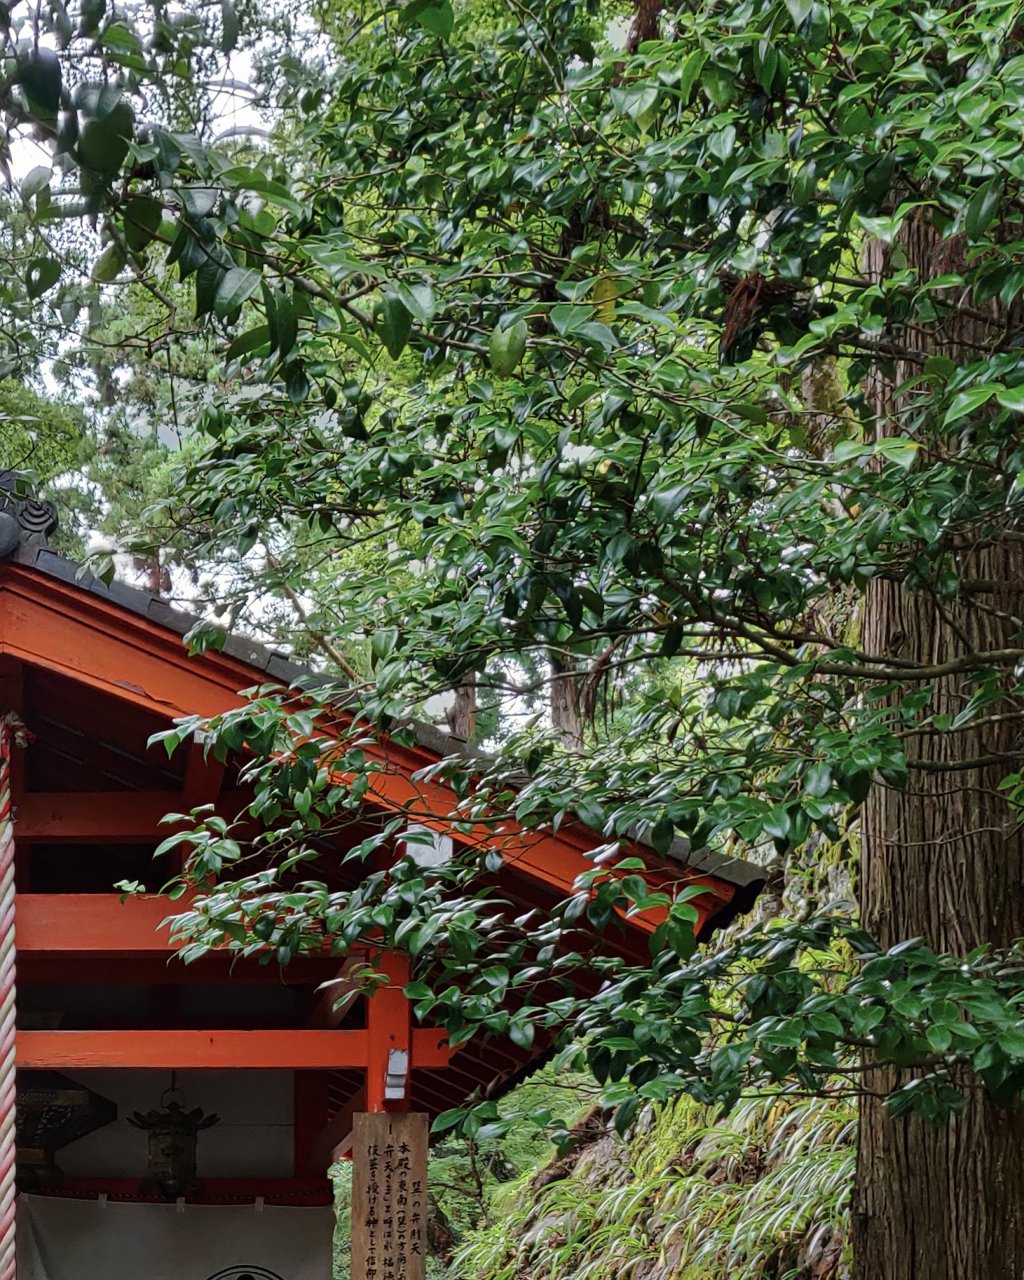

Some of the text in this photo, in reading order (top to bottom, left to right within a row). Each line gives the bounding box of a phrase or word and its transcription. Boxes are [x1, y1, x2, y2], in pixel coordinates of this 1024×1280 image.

[409, 1180, 423, 1255] 巽の弁財天
